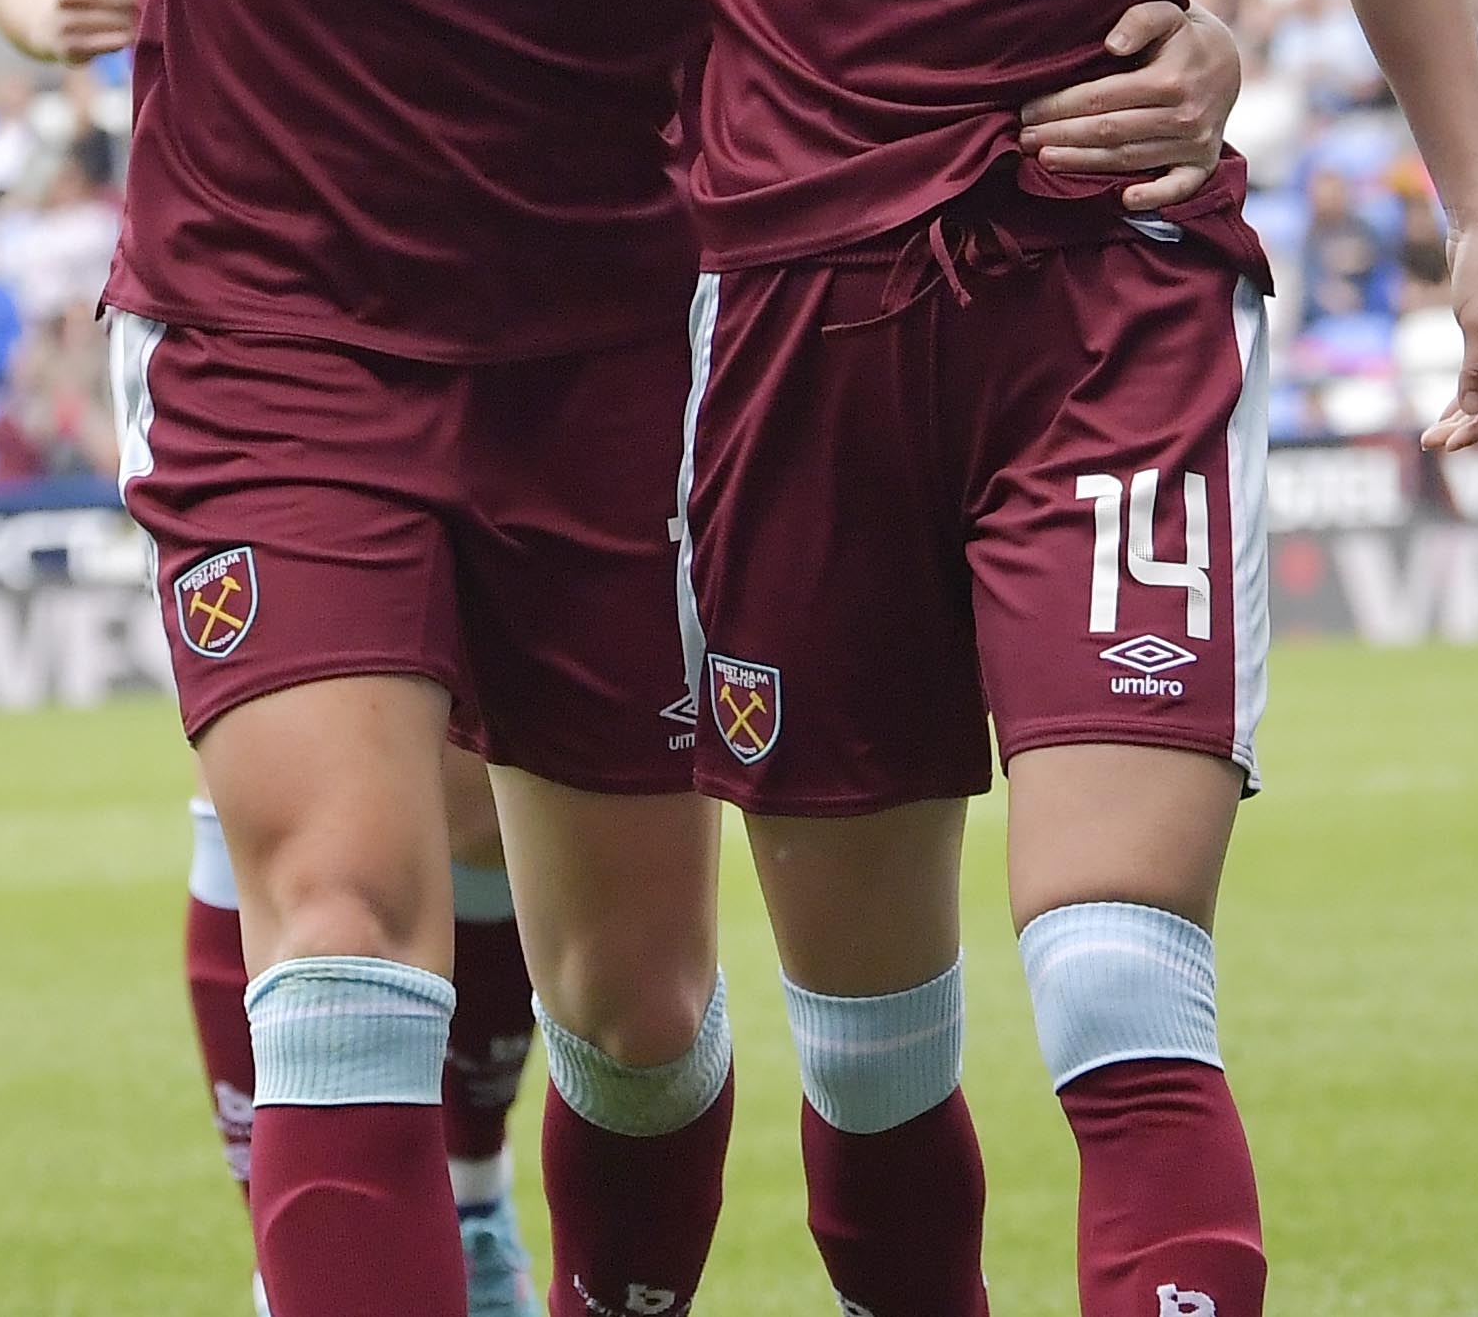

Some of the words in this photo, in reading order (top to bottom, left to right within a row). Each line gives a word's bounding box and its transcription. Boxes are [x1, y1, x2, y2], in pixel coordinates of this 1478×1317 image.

[1075, 468, 1212, 640] 14
[739, 669, 769, 685] HAM
[1111, 674, 1183, 696] umbro
